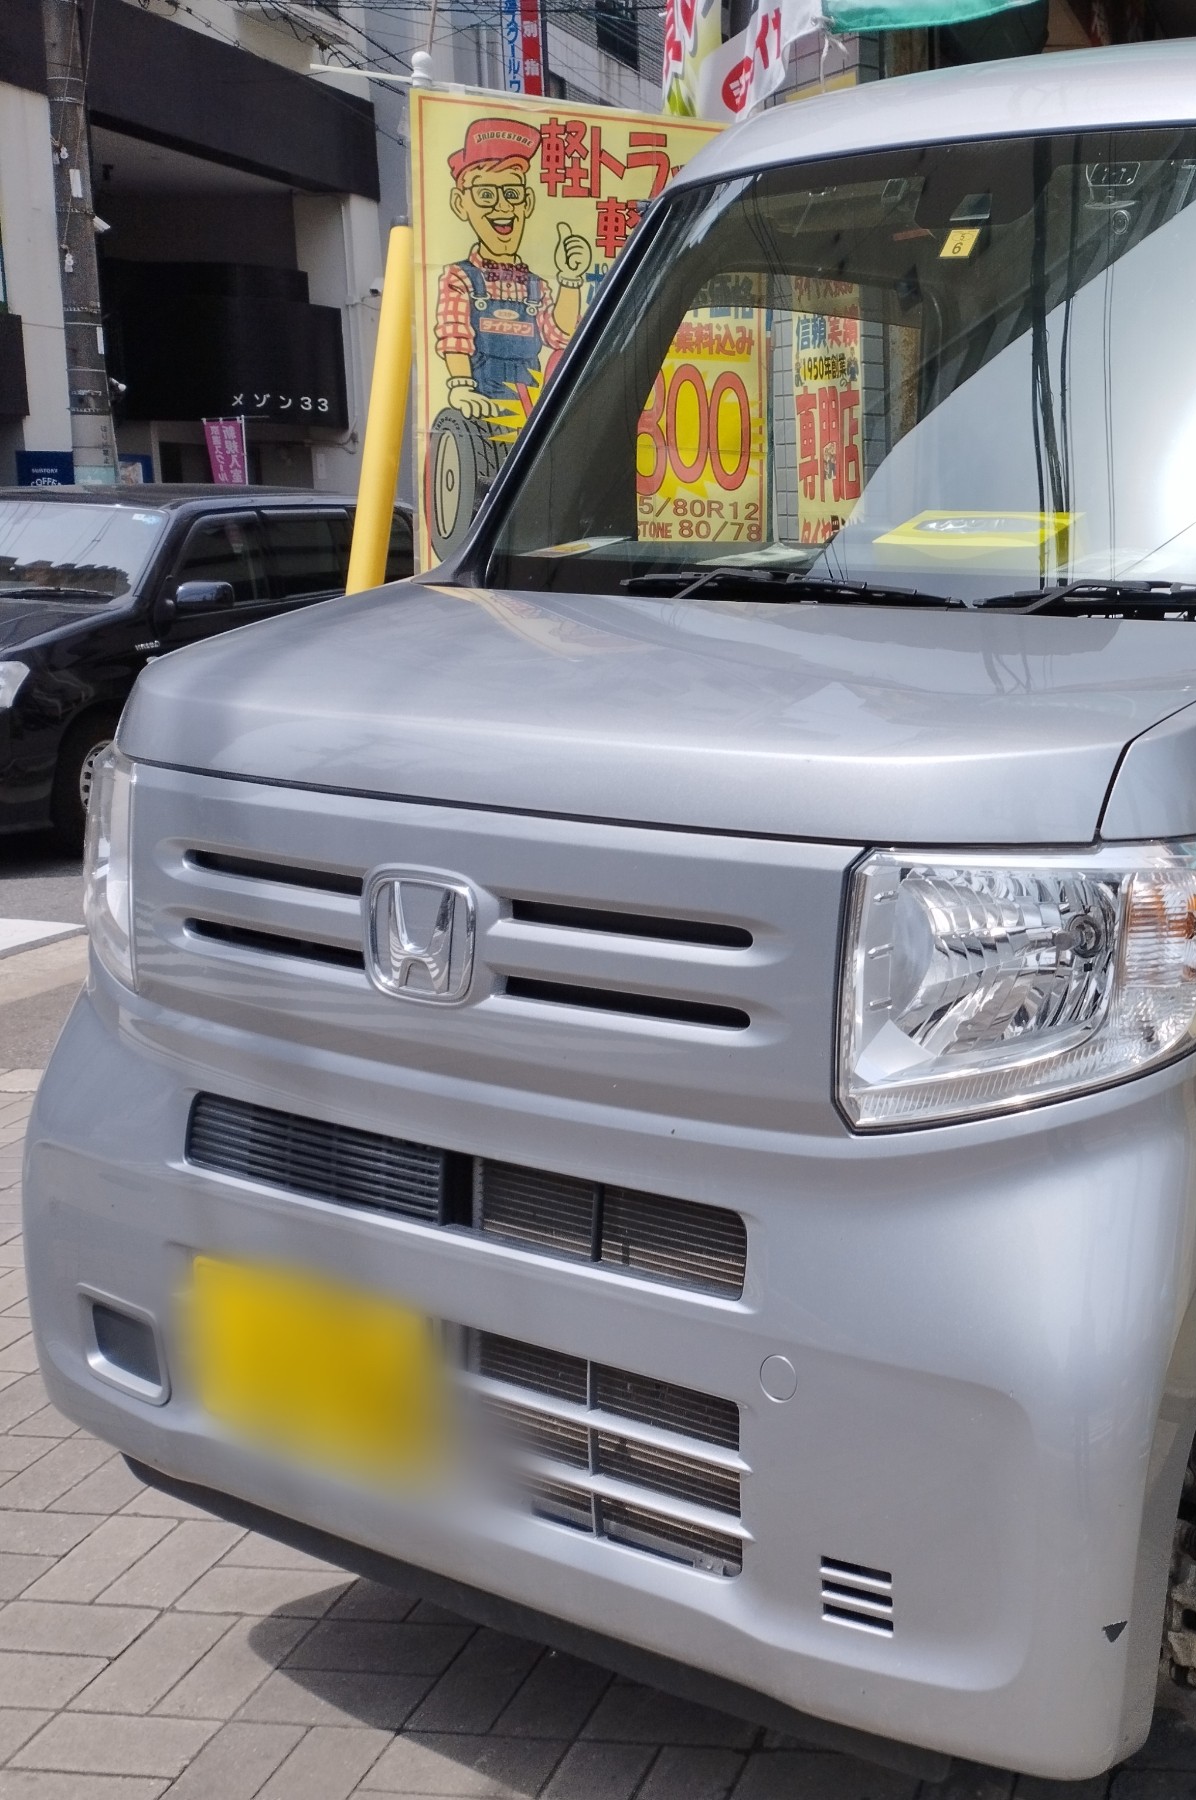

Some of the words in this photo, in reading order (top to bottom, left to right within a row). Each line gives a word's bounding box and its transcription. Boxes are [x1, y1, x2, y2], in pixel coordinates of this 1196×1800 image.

[474, 131, 534, 147] BRIDGESTONE
[952, 242, 964, 255] 6
[482, 319, 532, 335] タイヤマン
[672, 321, 755, 357] 業料込み
[231, 393, 329, 413] メゾン33
[795, 385, 861, 503] 専門店
[639, 496, 760, 522] 5/80R12
[678, 518, 762, 542] 80/78
